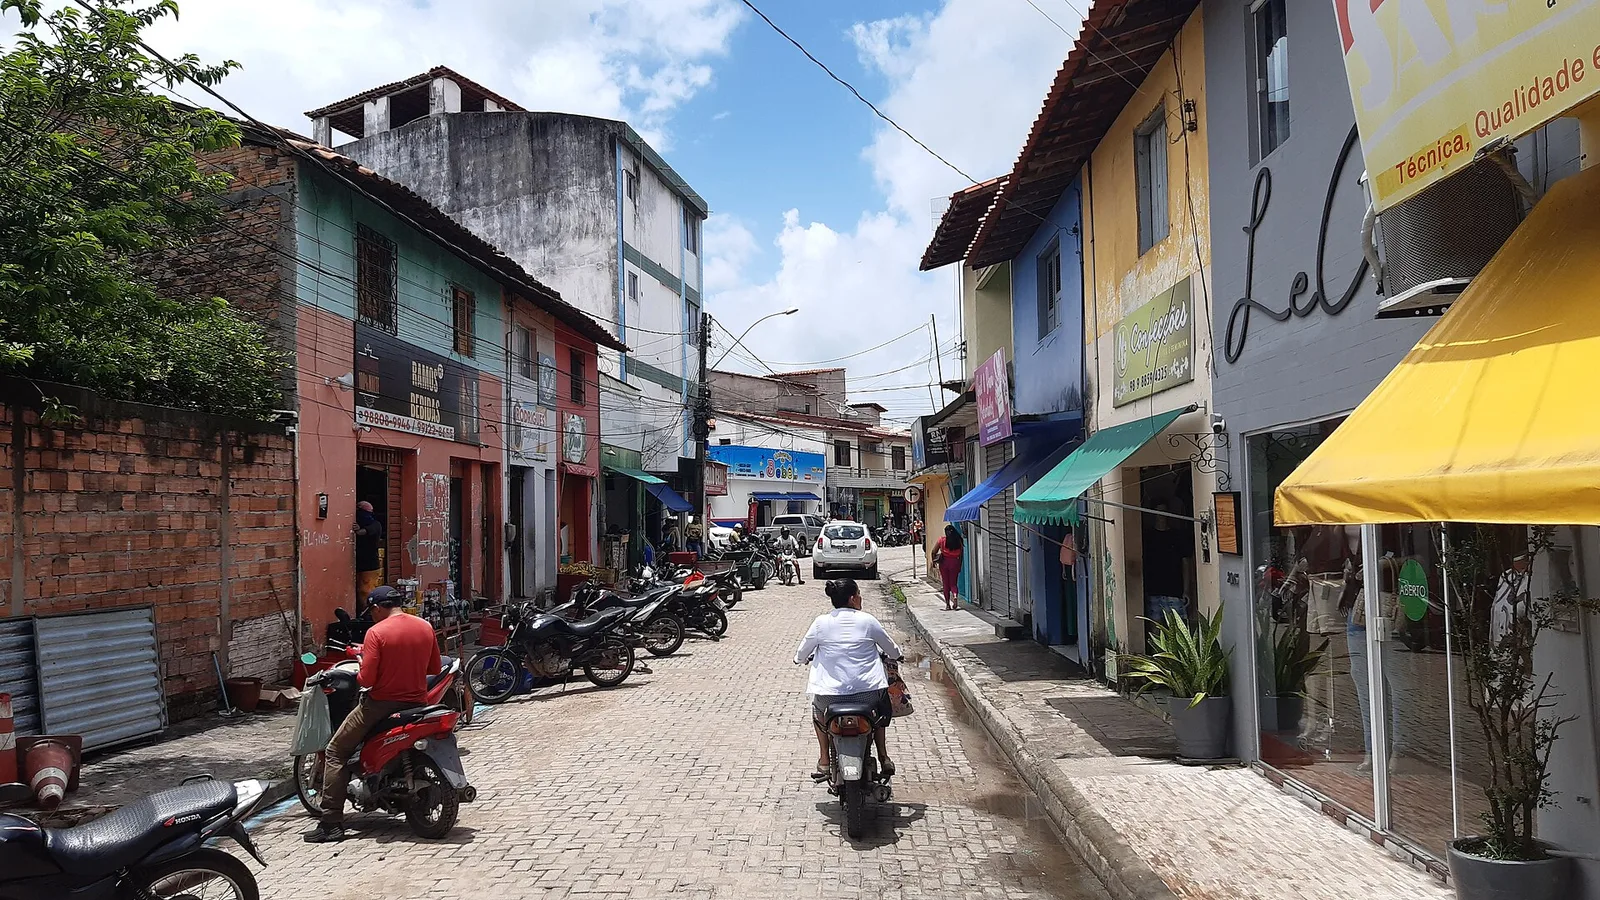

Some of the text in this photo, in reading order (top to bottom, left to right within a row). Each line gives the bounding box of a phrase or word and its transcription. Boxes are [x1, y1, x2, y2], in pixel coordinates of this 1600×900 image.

[1395, 131, 1471, 185] Técnica,
[1474, 58, 1585, 139] Qualidade
[411, 360, 439, 393] RAMOS
[410, 391, 441, 424] BEBIDAS
[1399, 584, 1426, 598] ABERTO
[175, 813, 202, 825] HONDA
